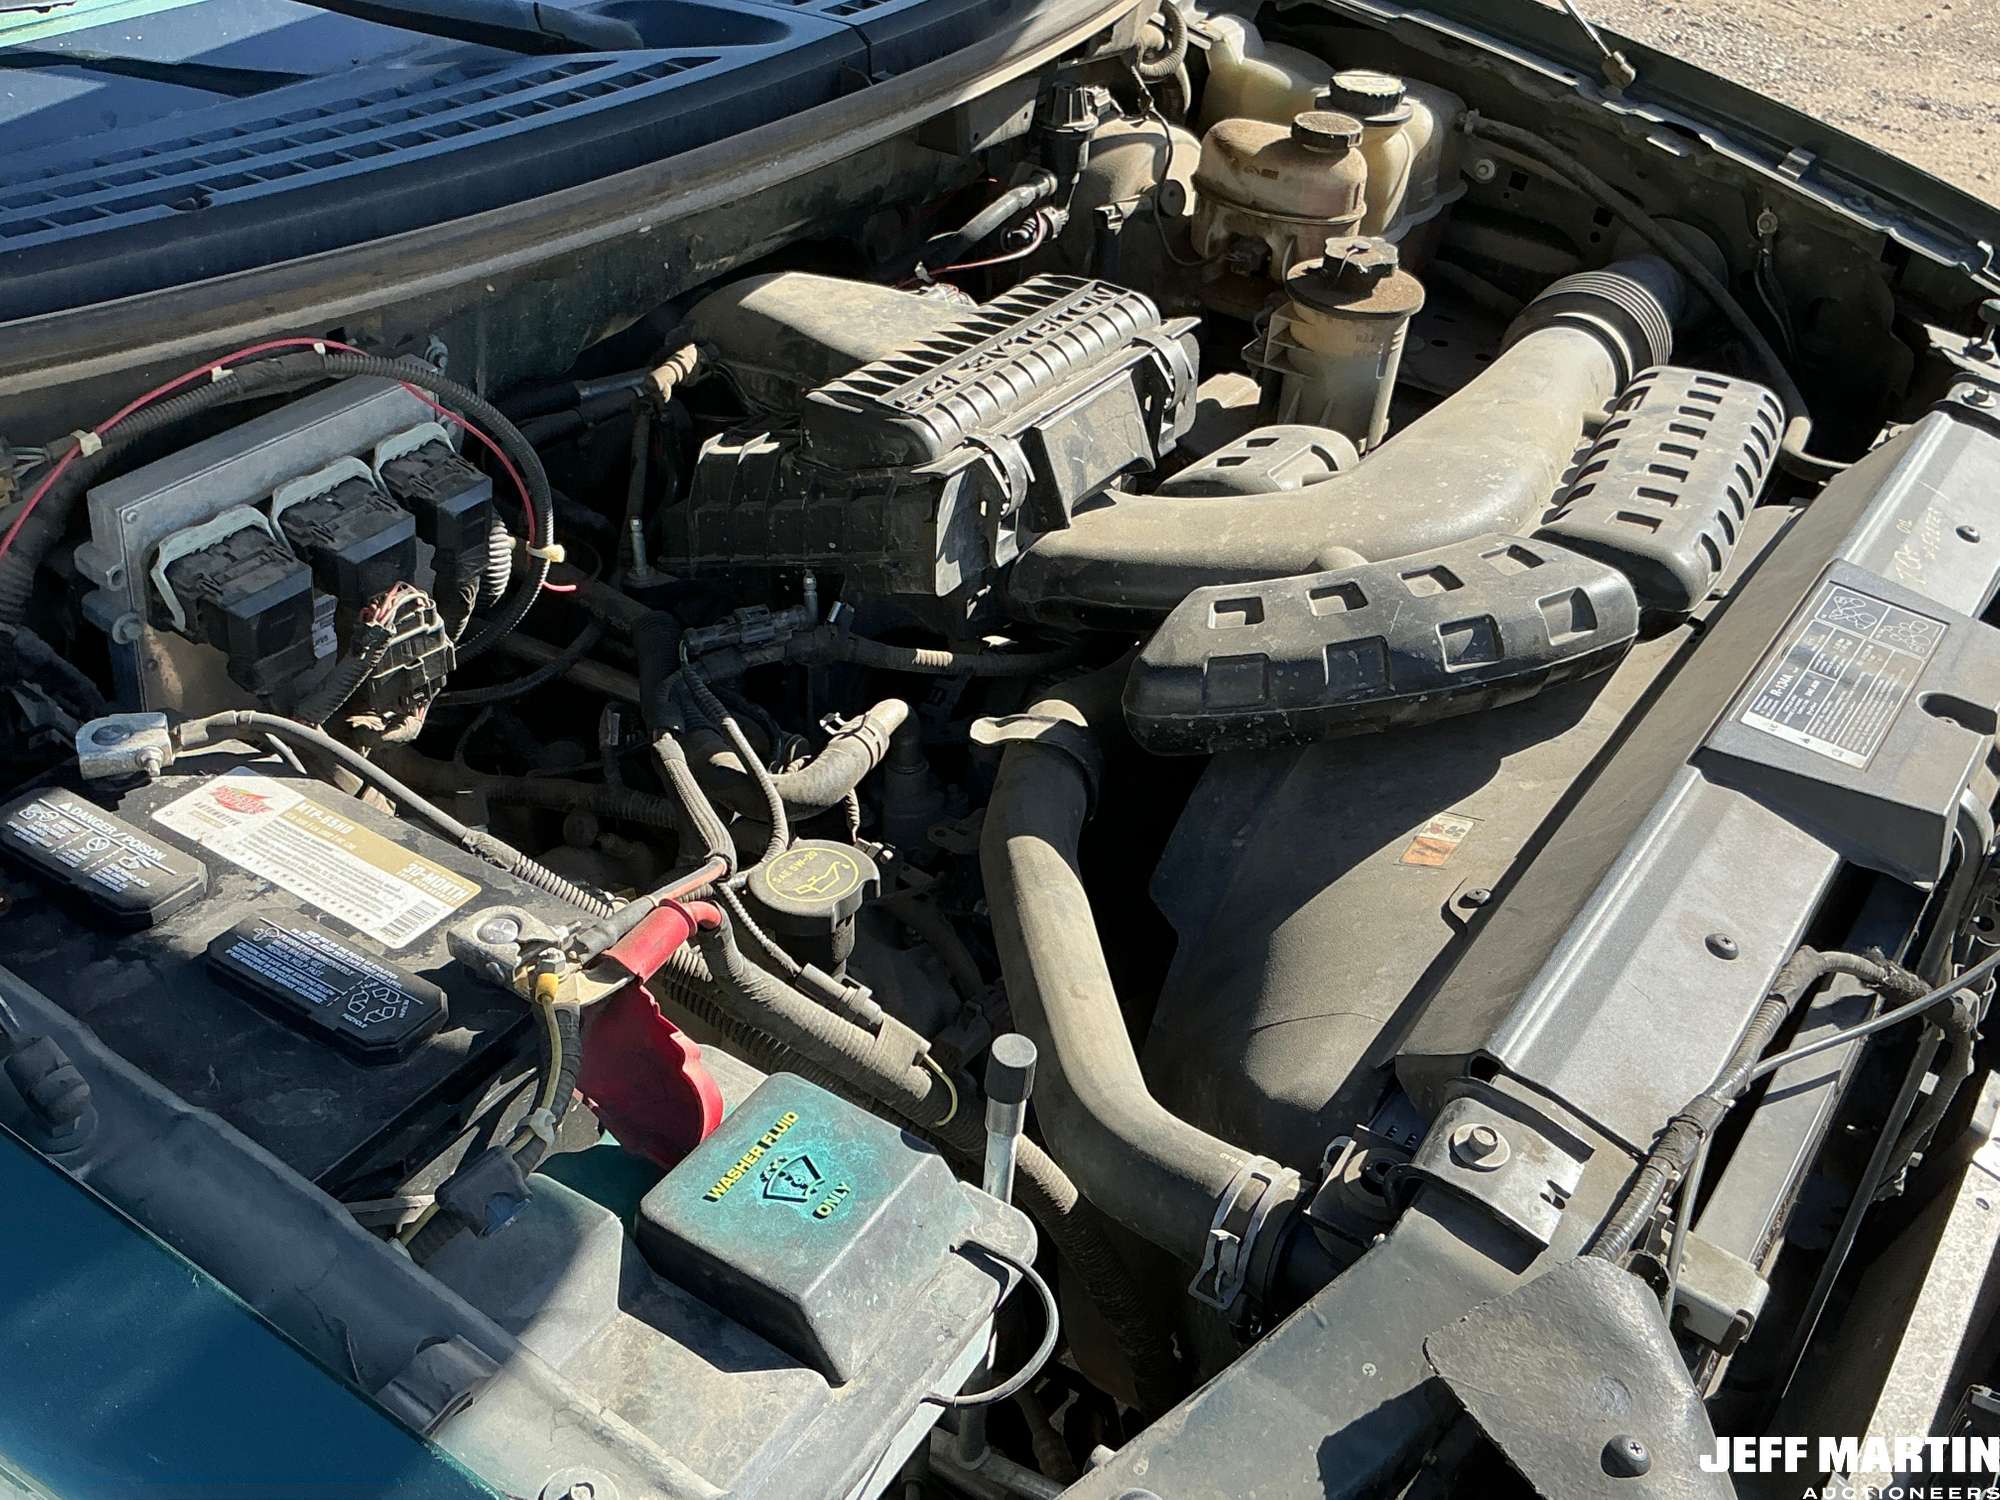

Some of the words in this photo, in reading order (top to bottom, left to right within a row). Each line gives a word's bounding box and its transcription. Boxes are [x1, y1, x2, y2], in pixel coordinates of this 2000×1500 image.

[1769, 672, 1794, 697] R-134A
[293, 799, 355, 836] MTP-65HD
[789, 850, 819, 872] 5W-20
[401, 861, 469, 900] 30-MONTH
[264, 943, 294, 961] MEDICAL
[290, 957, 308, 969] HELP
[304, 964, 324, 978] FAST
[271, 939, 289, 951] WITH
[308, 958, 326, 970] GET
[277, 933, 300, 948] FLUSH
[295, 943, 315, 956] EYES
[311, 951, 354, 977] IMMEDIATELY
[342, 1013, 368, 1029] RECYCLE
[704, 1144, 766, 1202] WASHER
[761, 1110, 800, 1147] FLUID
[813, 1182, 852, 1219] ONLY
